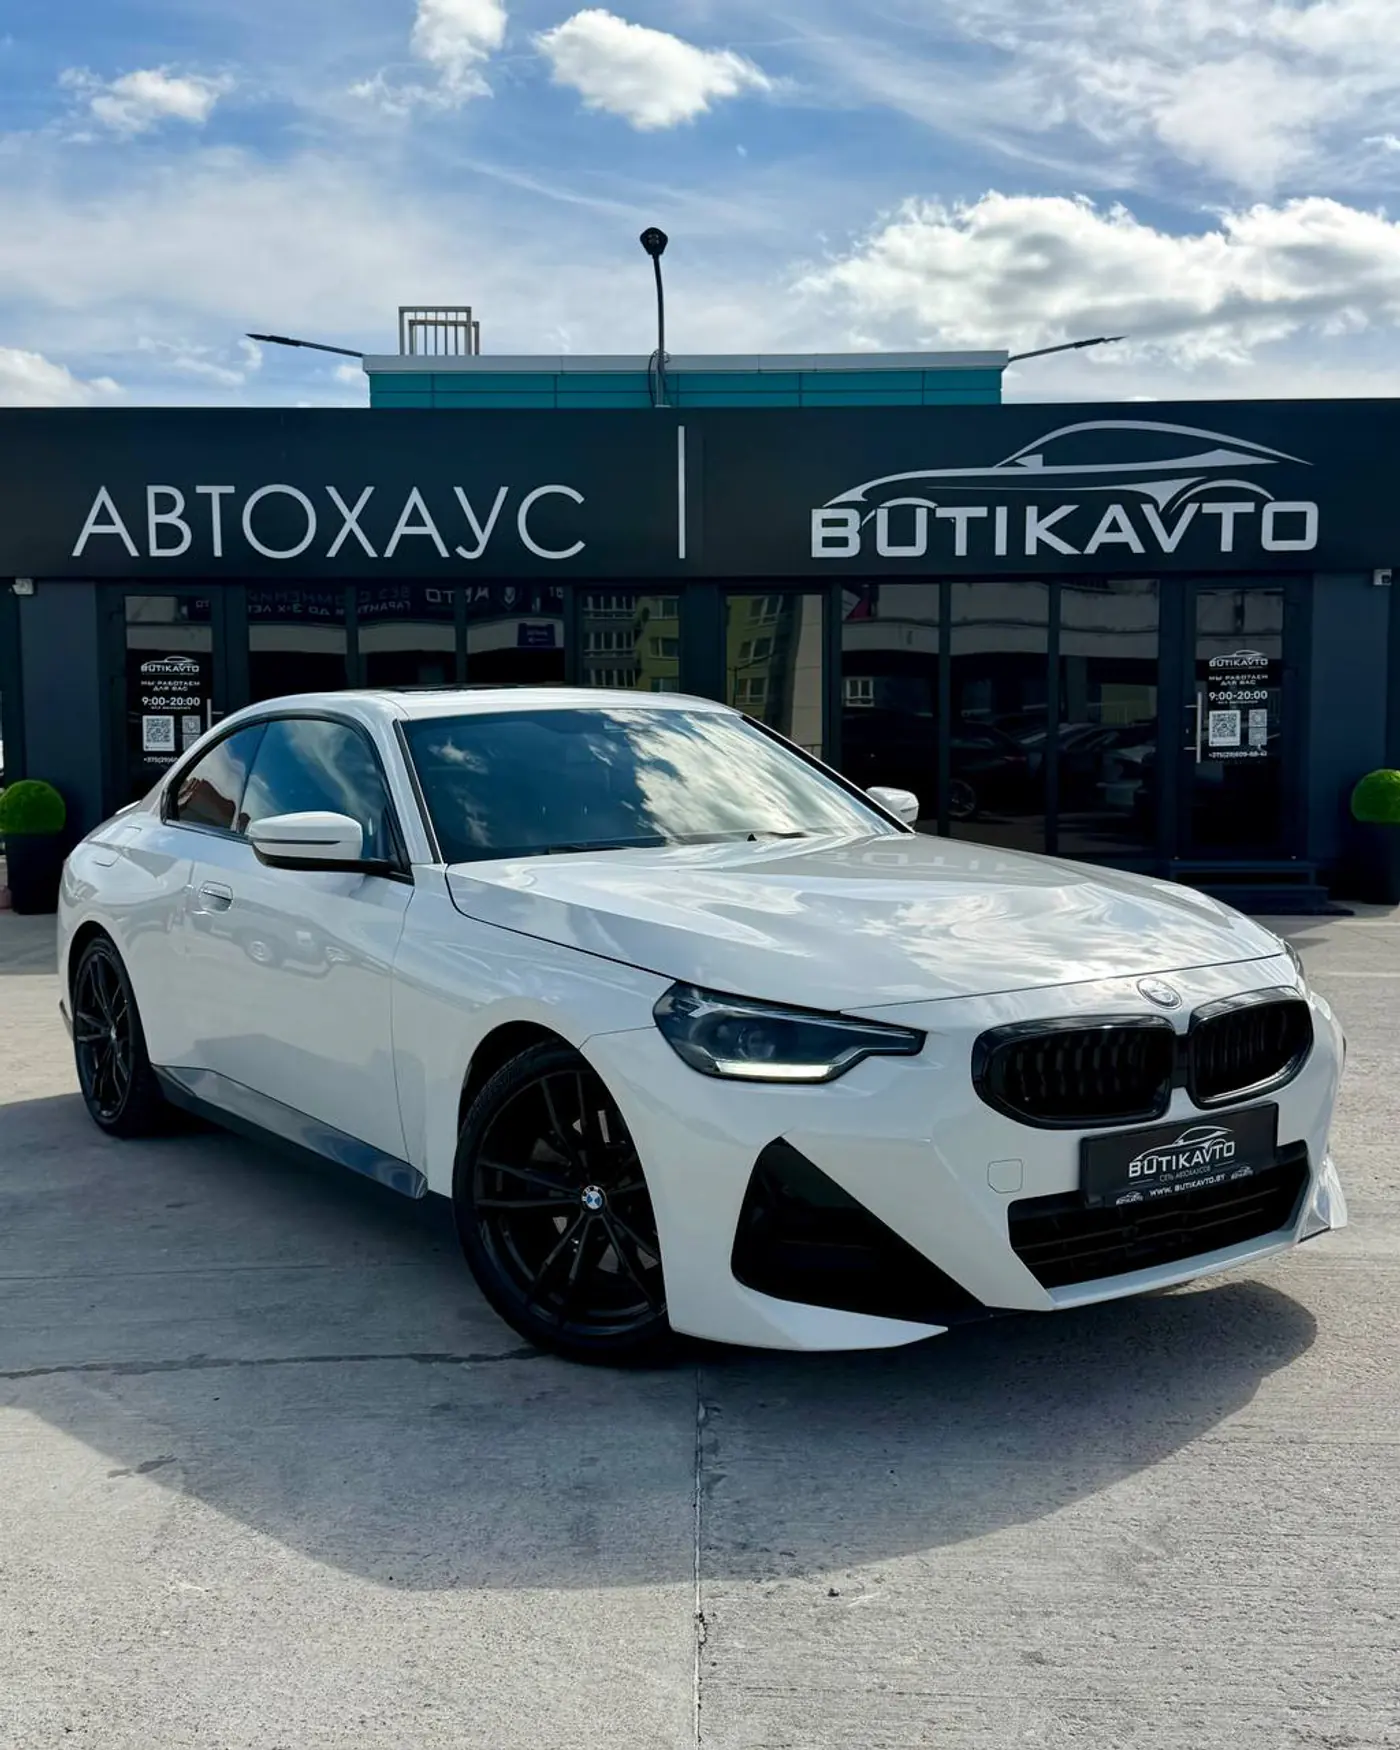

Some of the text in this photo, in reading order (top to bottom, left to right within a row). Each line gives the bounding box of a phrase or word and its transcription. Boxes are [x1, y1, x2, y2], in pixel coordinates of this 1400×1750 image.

[72, 484, 586, 559] АВТОХАУС
[811, 501, 1319, 558] BUTIKAVTO
[1208, 658, 1268, 667] BUTIKAVTO
[140, 664, 200, 673] BUTIKAVTO
[141, 696, 200, 706] 9:00-20:00
[1208, 690, 1268, 701] 9:00-20:00
[1128, 1141, 1235, 1178] BUTIKAVTO
